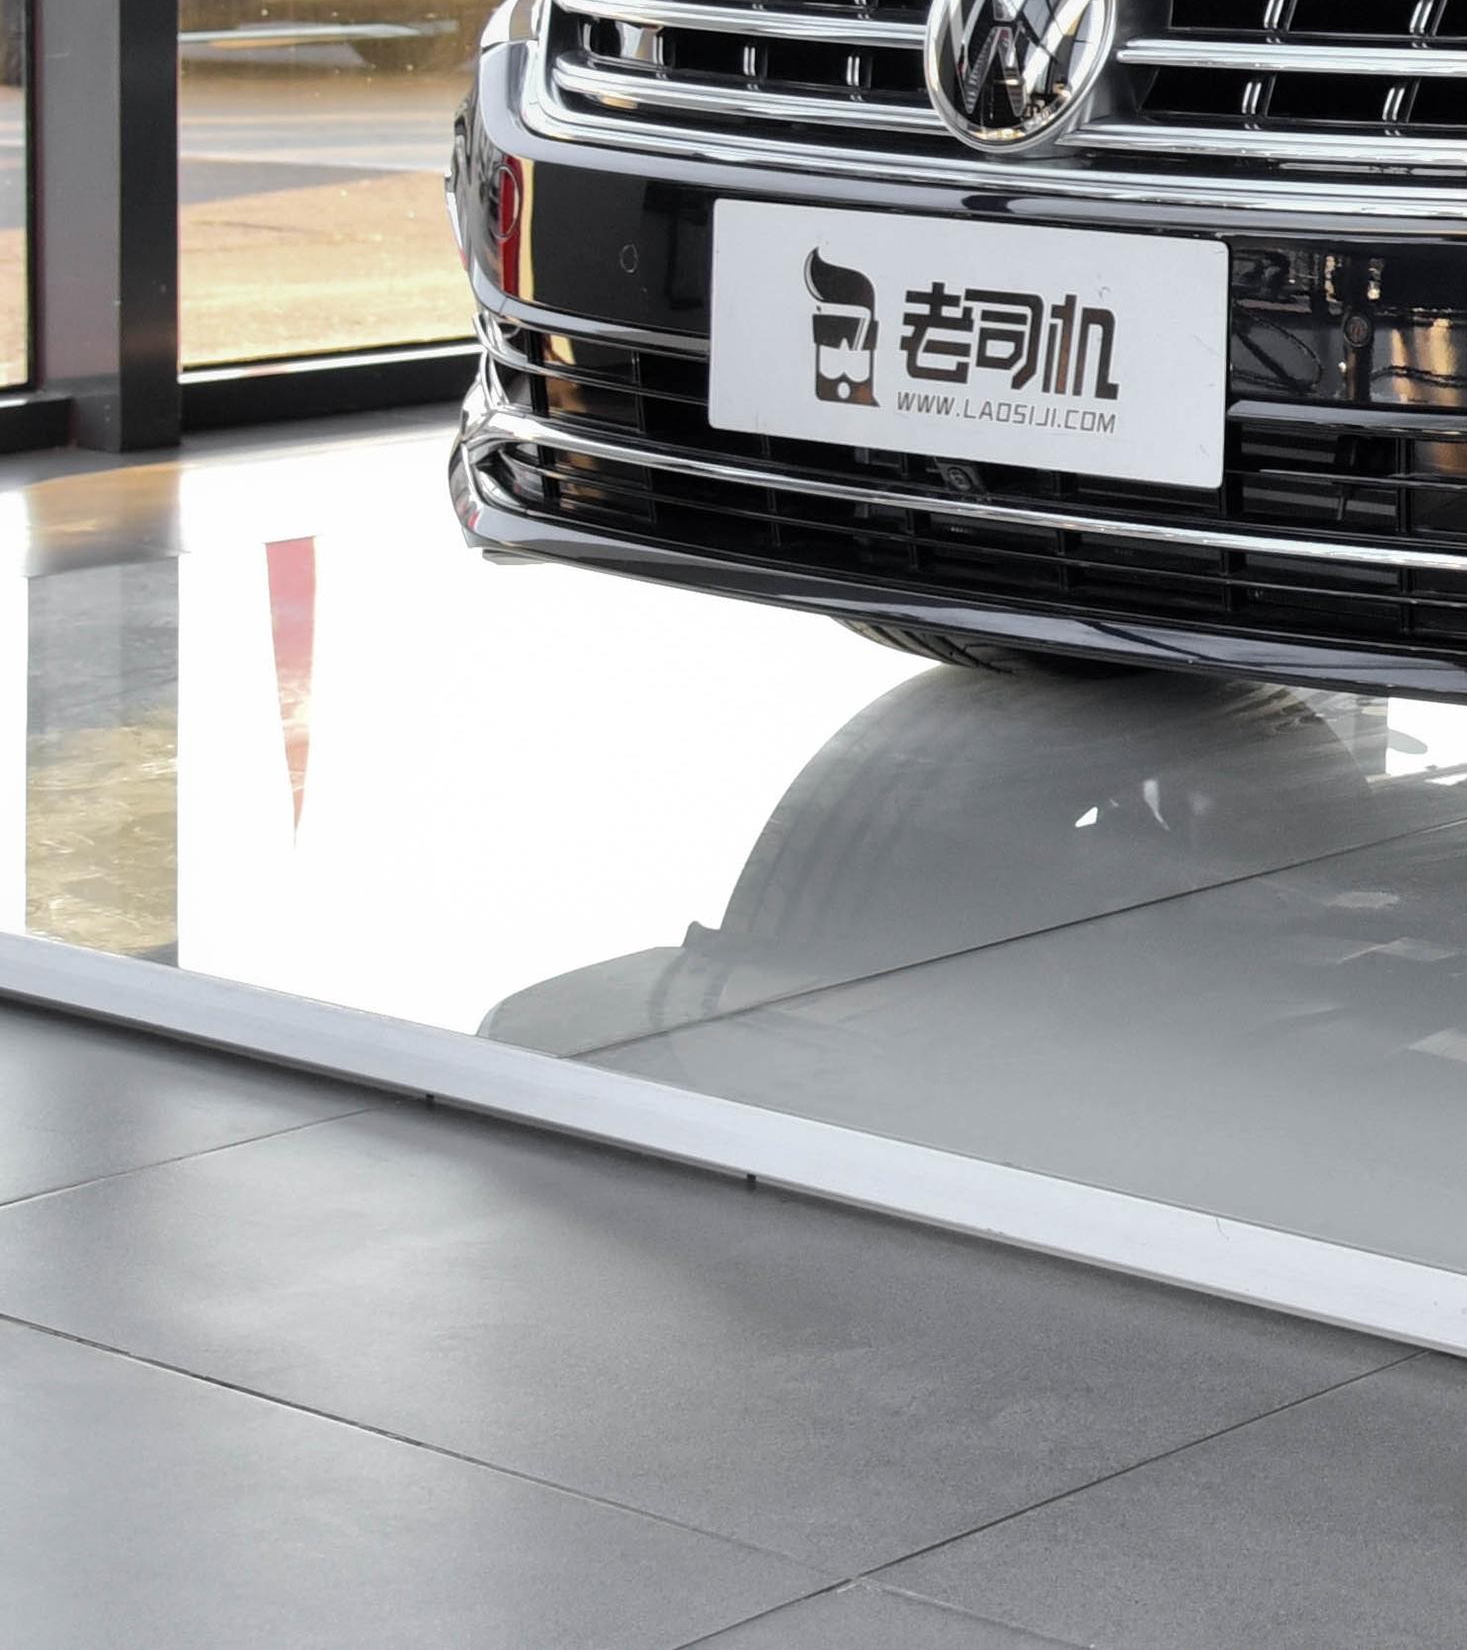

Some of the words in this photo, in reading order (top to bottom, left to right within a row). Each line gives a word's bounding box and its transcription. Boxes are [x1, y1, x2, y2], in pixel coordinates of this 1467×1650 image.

[900, 281, 1119, 400] 老司机
[897, 391, 1117, 434] WWW.LAOSIJI.COM
